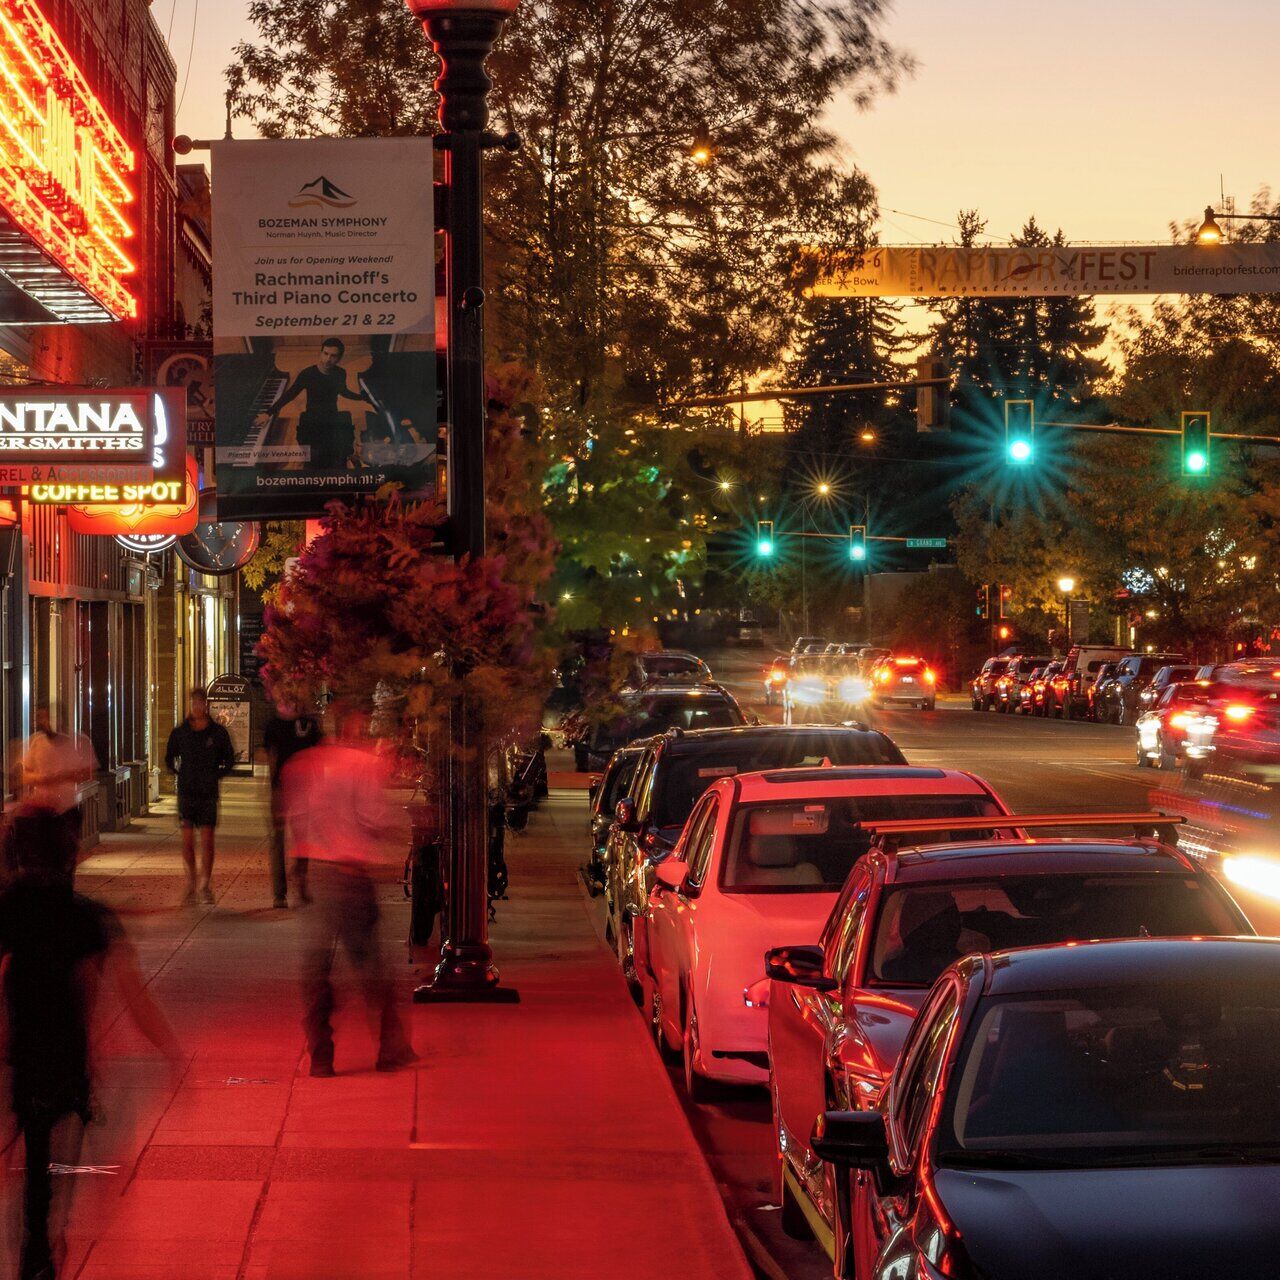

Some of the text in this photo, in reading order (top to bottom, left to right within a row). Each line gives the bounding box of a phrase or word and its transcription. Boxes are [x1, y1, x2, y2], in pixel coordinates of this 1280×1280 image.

[258, 217, 387, 228] BOZEMAN SYMPHONY
[254, 257, 275, 265] Join
[290, 256, 303, 264] for
[306, 256, 345, 265] Opening
[348, 255, 393, 263] Weekend!
[920, 251, 1156, 286] RAPTOR FEST
[255, 271, 389, 286] Rachmaninoff's
[853, 277, 879, 287] BOWL
[938, 284, 1028, 294] migration
[1043, 281, 1150, 292] celebration
[232, 290, 417, 305] Third Piano Concerto
[255, 314, 396, 329] September 21 & 22
[31, 466, 42, 481] &
[31, 481, 182, 501] COFFEE SPOT
